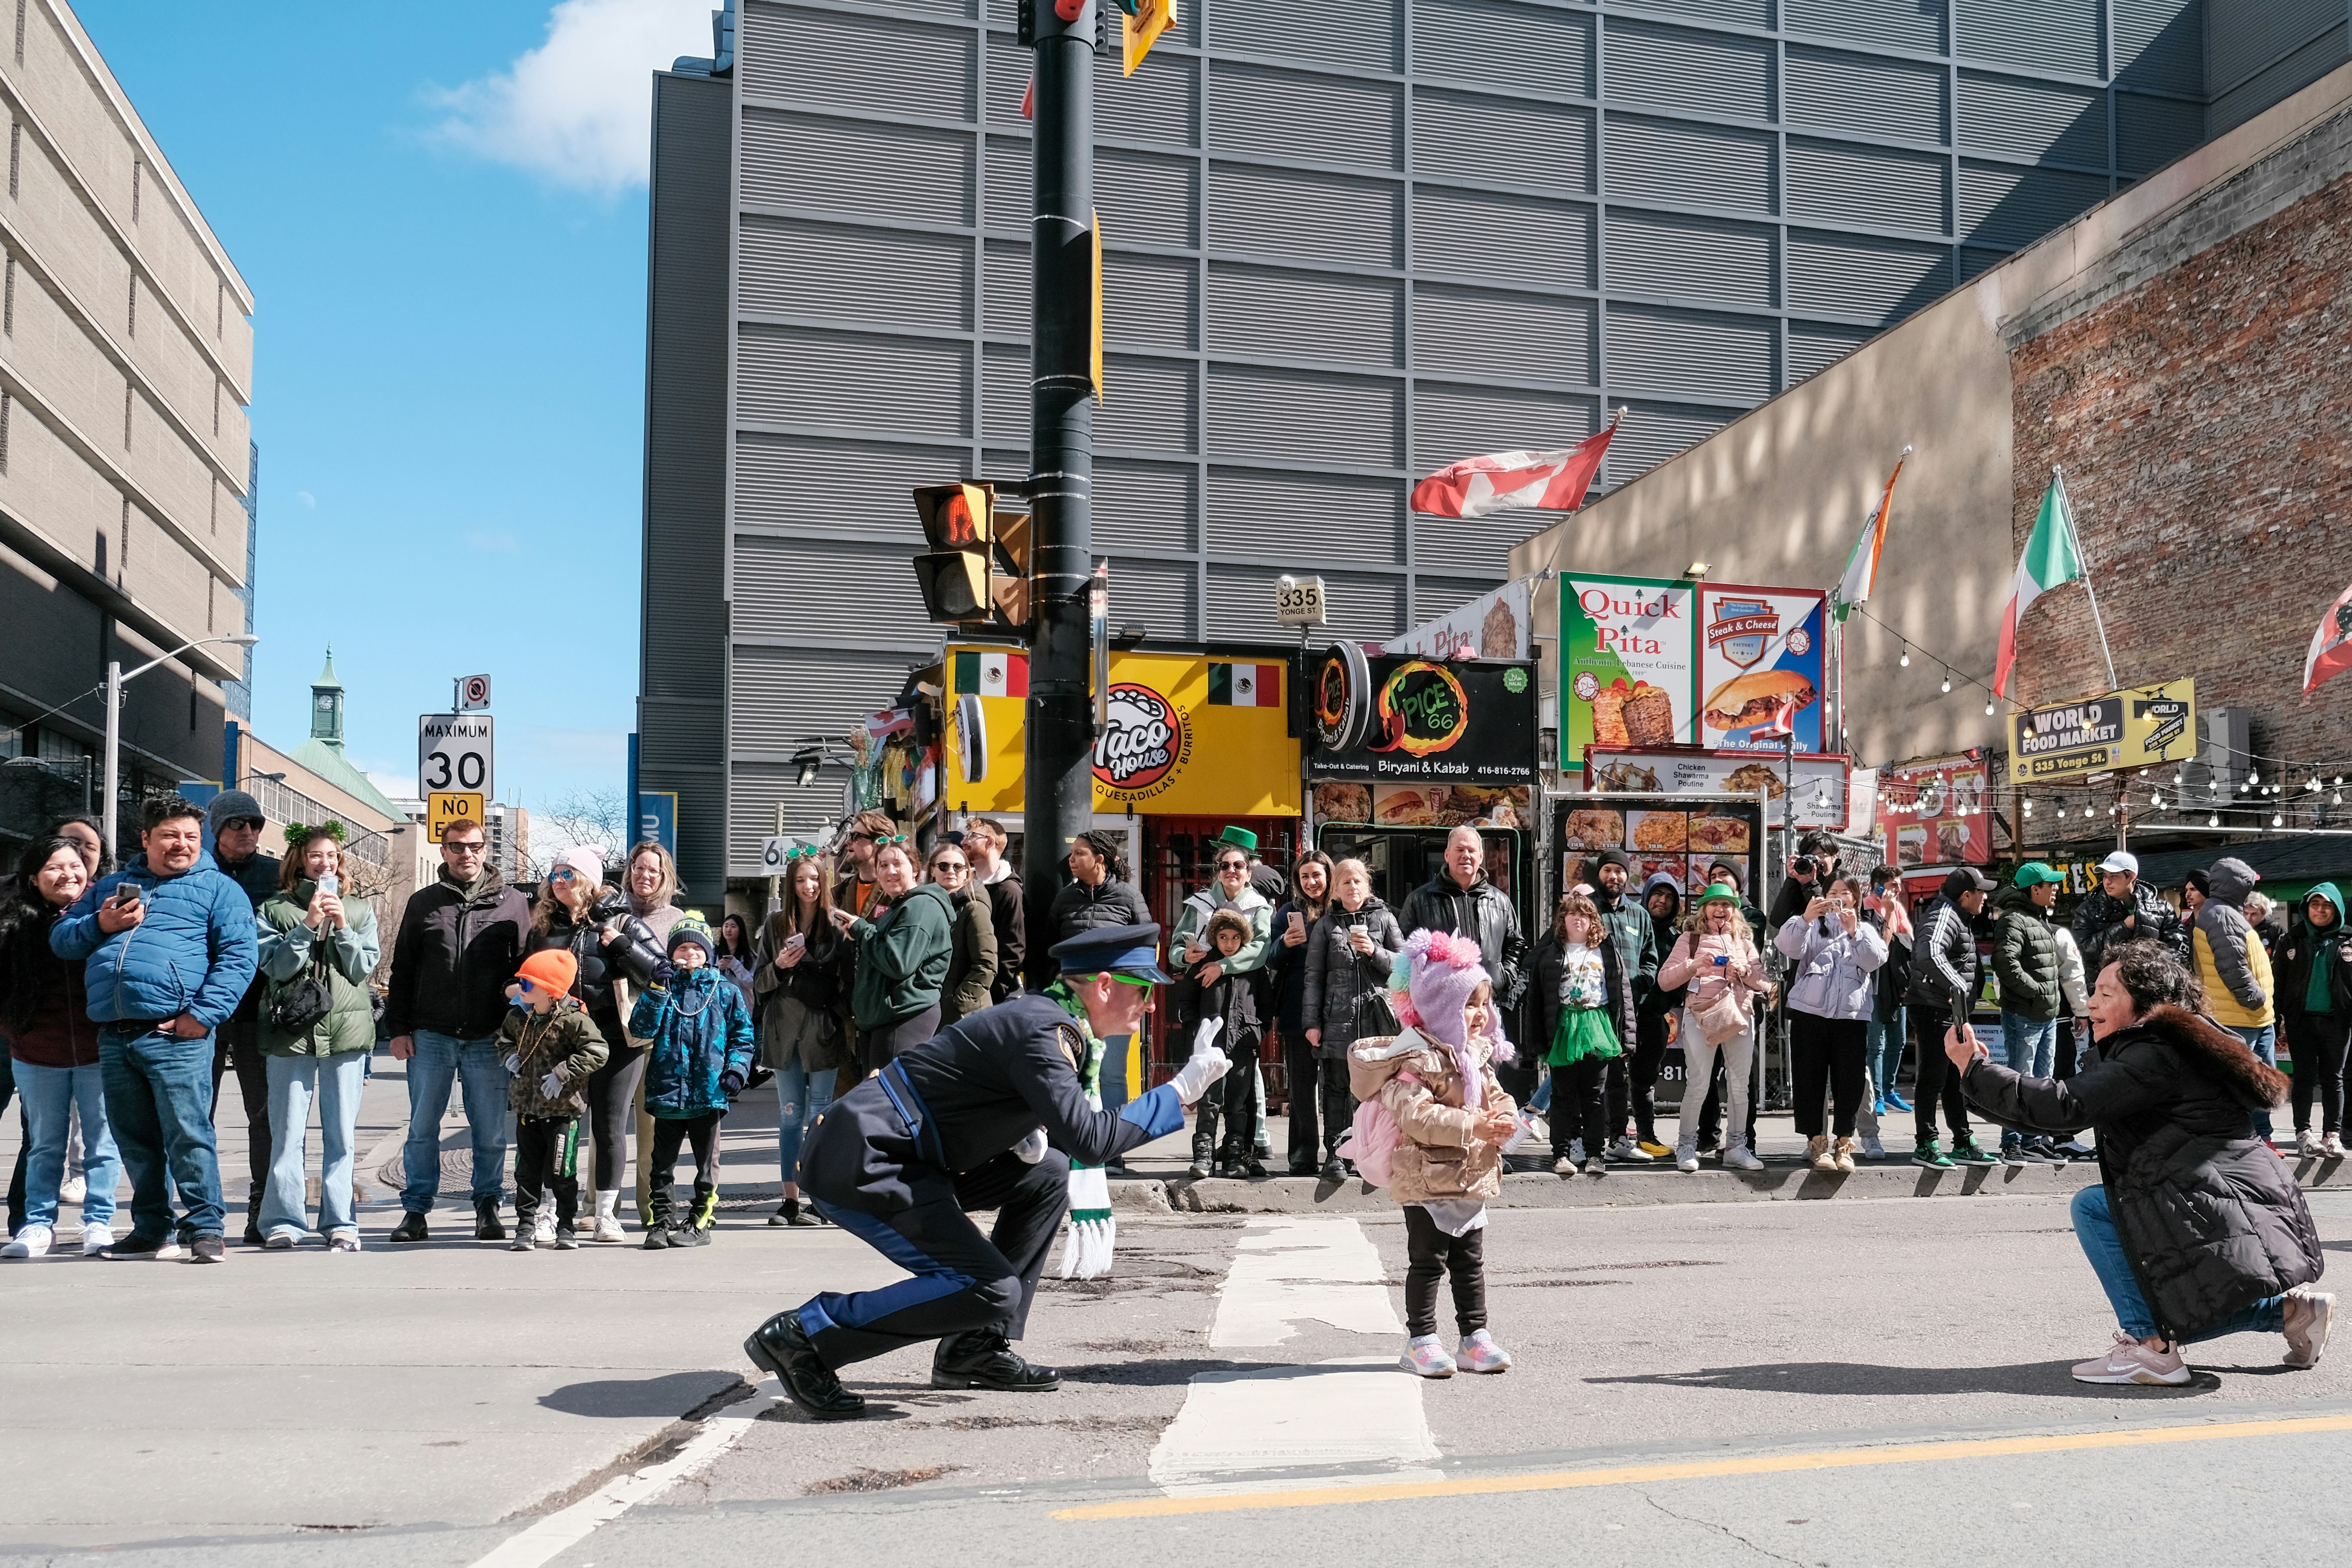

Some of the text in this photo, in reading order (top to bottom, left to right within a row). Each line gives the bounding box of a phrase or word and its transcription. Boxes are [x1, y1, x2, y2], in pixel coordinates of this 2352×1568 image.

[1280, 589, 1317, 608] 335
[1579, 589, 1681, 621] Quick
[1709, 620, 1776, 639] Steak & Cheese
[1595, 627, 1661, 654] Pita
[1574, 656, 1686, 670] Authentic Lebanese Cuisine
[2149, 704, 2179, 715] ORLD
[1317, 697, 1350, 743] Biryani & Kabab
[1428, 713, 1453, 729] 66
[2034, 705, 2102, 734] WORLD
[425, 725, 487, 738] MAXIMUM
[1177, 705, 1193, 765] BURRITOS
[2022, 724, 2117, 753] FOOD MARKET
[2145, 718, 2184, 746] FOOD MARKET
[1096, 721, 1171, 766] Taco
[1780, 741, 1808, 752] Pilly
[426, 752, 485, 789] 30
[1110, 749, 1169, 780] House
[1346, 763, 1369, 772] Catering
[1378, 760, 1469, 775] Biryani & Kabab
[1478, 766, 1530, 775] 416-816-2766
[2035, 762, 2054, 772] 335
[2058, 757, 2089, 769] Yonge
[2091, 753, 2106, 764] St.
[1673, 771, 1709, 780] Shawarma
[1096, 775, 1176, 801] QUESADILLAS
[443, 799, 468, 816] NO
[642, 815, 660, 843] MU
[2050, 862, 2098, 894] TES
[1659, 1066, 1688, 1081] -81
